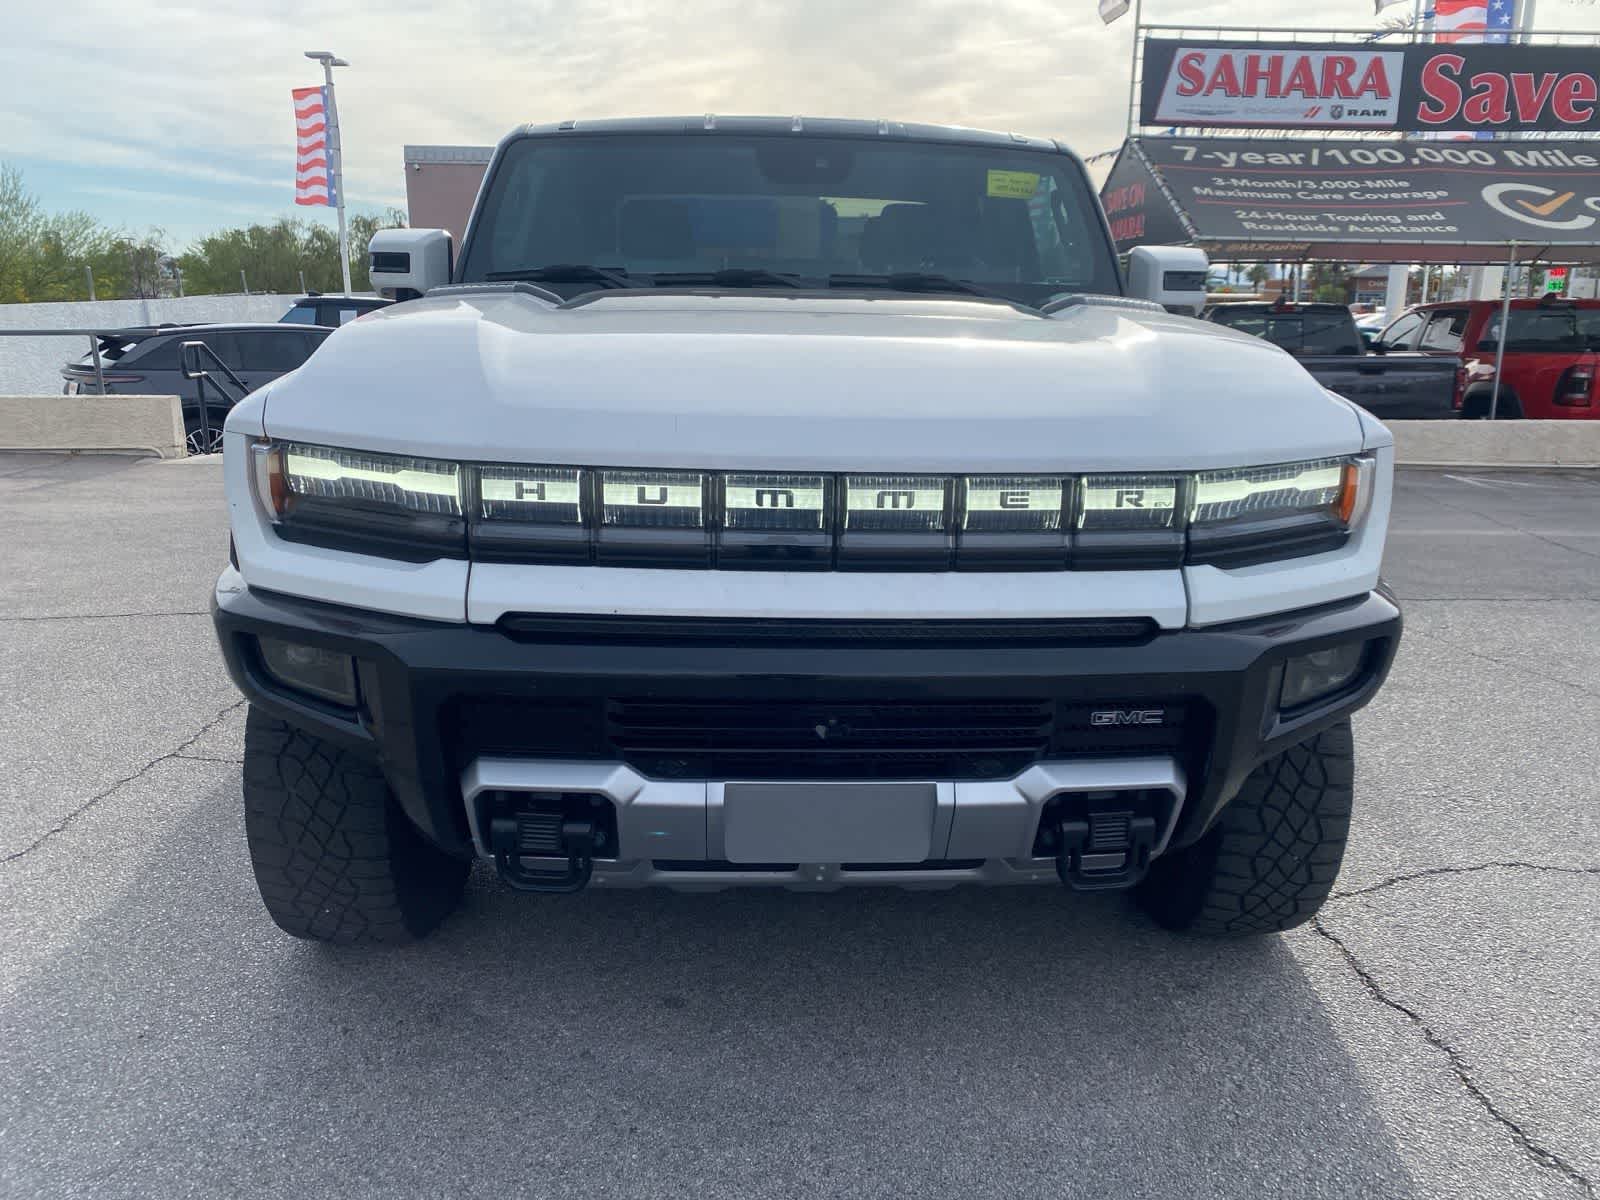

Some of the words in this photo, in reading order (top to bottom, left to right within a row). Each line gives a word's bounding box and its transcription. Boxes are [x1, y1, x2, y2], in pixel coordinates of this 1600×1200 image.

[1176, 52, 1392, 99] SAHARA
[1417, 54, 1598, 124] Save
[1347, 109, 1387, 117] RAM
[1504, 150, 1600, 166] Mile
[1192, 186, 1293, 200] Maximum
[1297, 191, 1345, 200] Care
[1349, 189, 1449, 200] Coverage
[1234, 210, 1319, 221] 24-Hour
[1321, 213, 1401, 223] Towing
[1407, 212, 1446, 222] and
[1242, 221, 1341, 232] Roadside
[1348, 223, 1459, 233] Assistance
[1091, 709, 1164, 725] GMC
